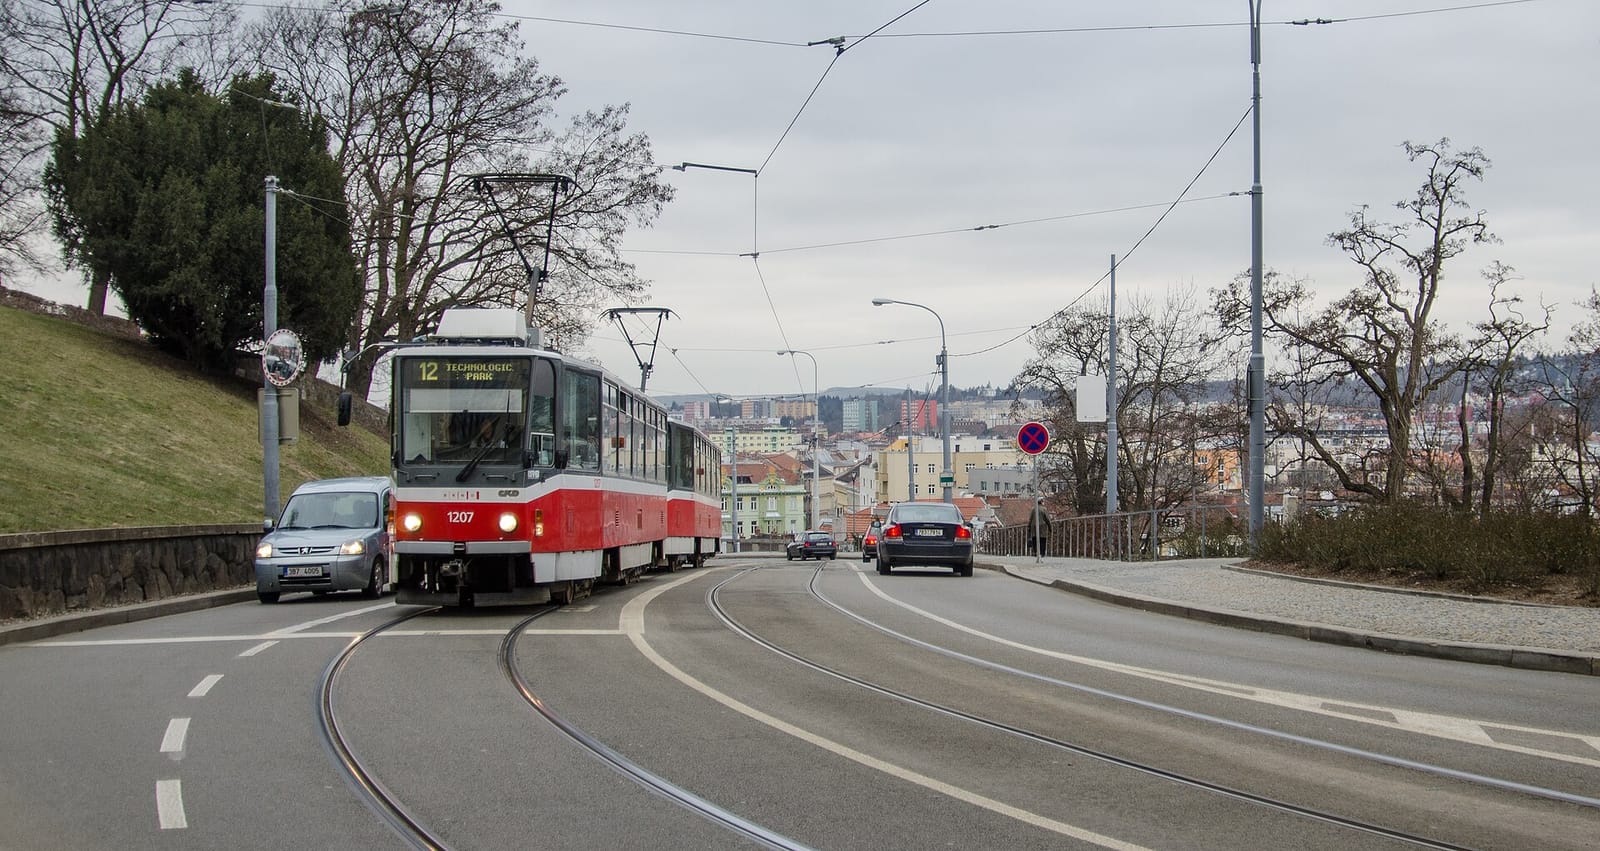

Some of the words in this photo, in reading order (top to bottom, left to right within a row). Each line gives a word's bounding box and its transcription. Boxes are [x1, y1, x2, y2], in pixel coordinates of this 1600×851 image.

[419, 362, 438, 381] 12
[446, 363, 512, 372] TECHNOLOGIC
[466, 372, 493, 381] PARK
[447, 511, 474, 523] 1207
